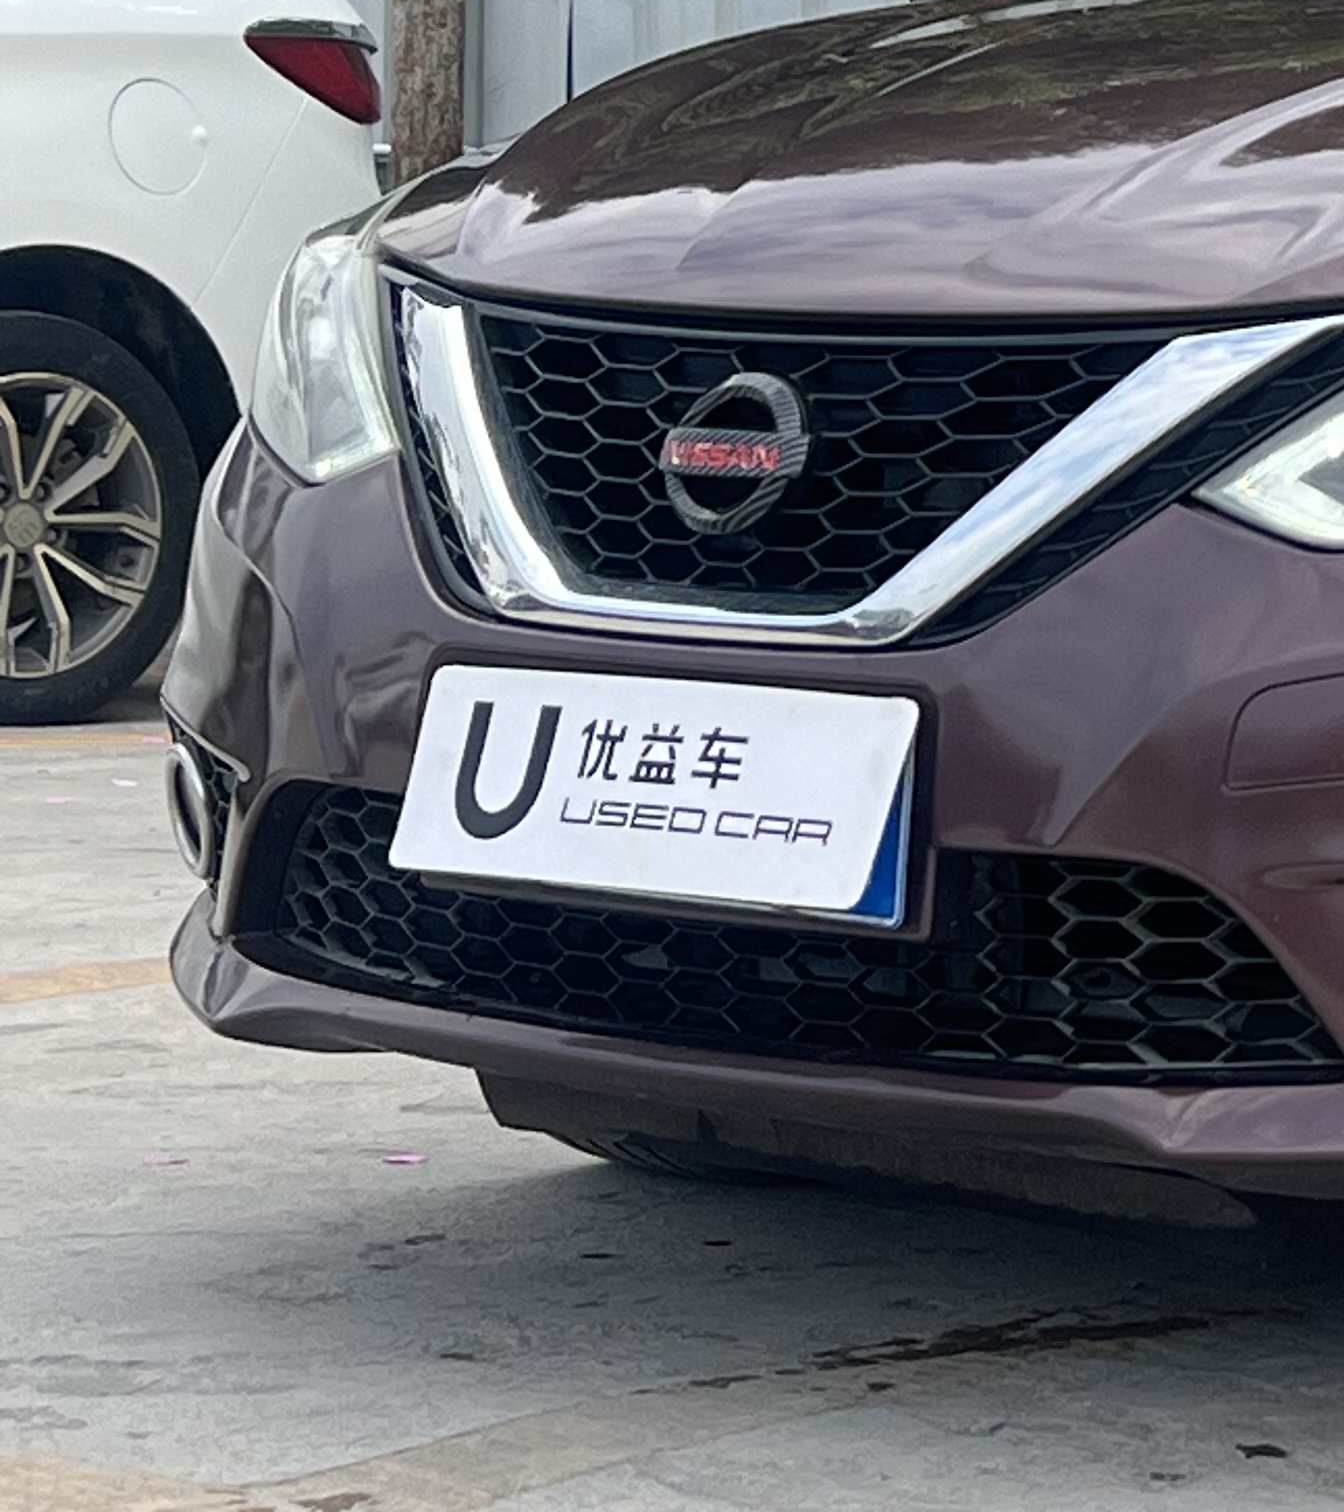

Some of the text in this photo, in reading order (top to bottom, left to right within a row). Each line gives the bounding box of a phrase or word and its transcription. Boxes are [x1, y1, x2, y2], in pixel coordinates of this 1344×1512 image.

[669, 440, 781, 472] NISSAN
[455, 701, 563, 840] U
[577, 718, 749, 790] 优益车
[560, 797, 833, 847] USED CAR
